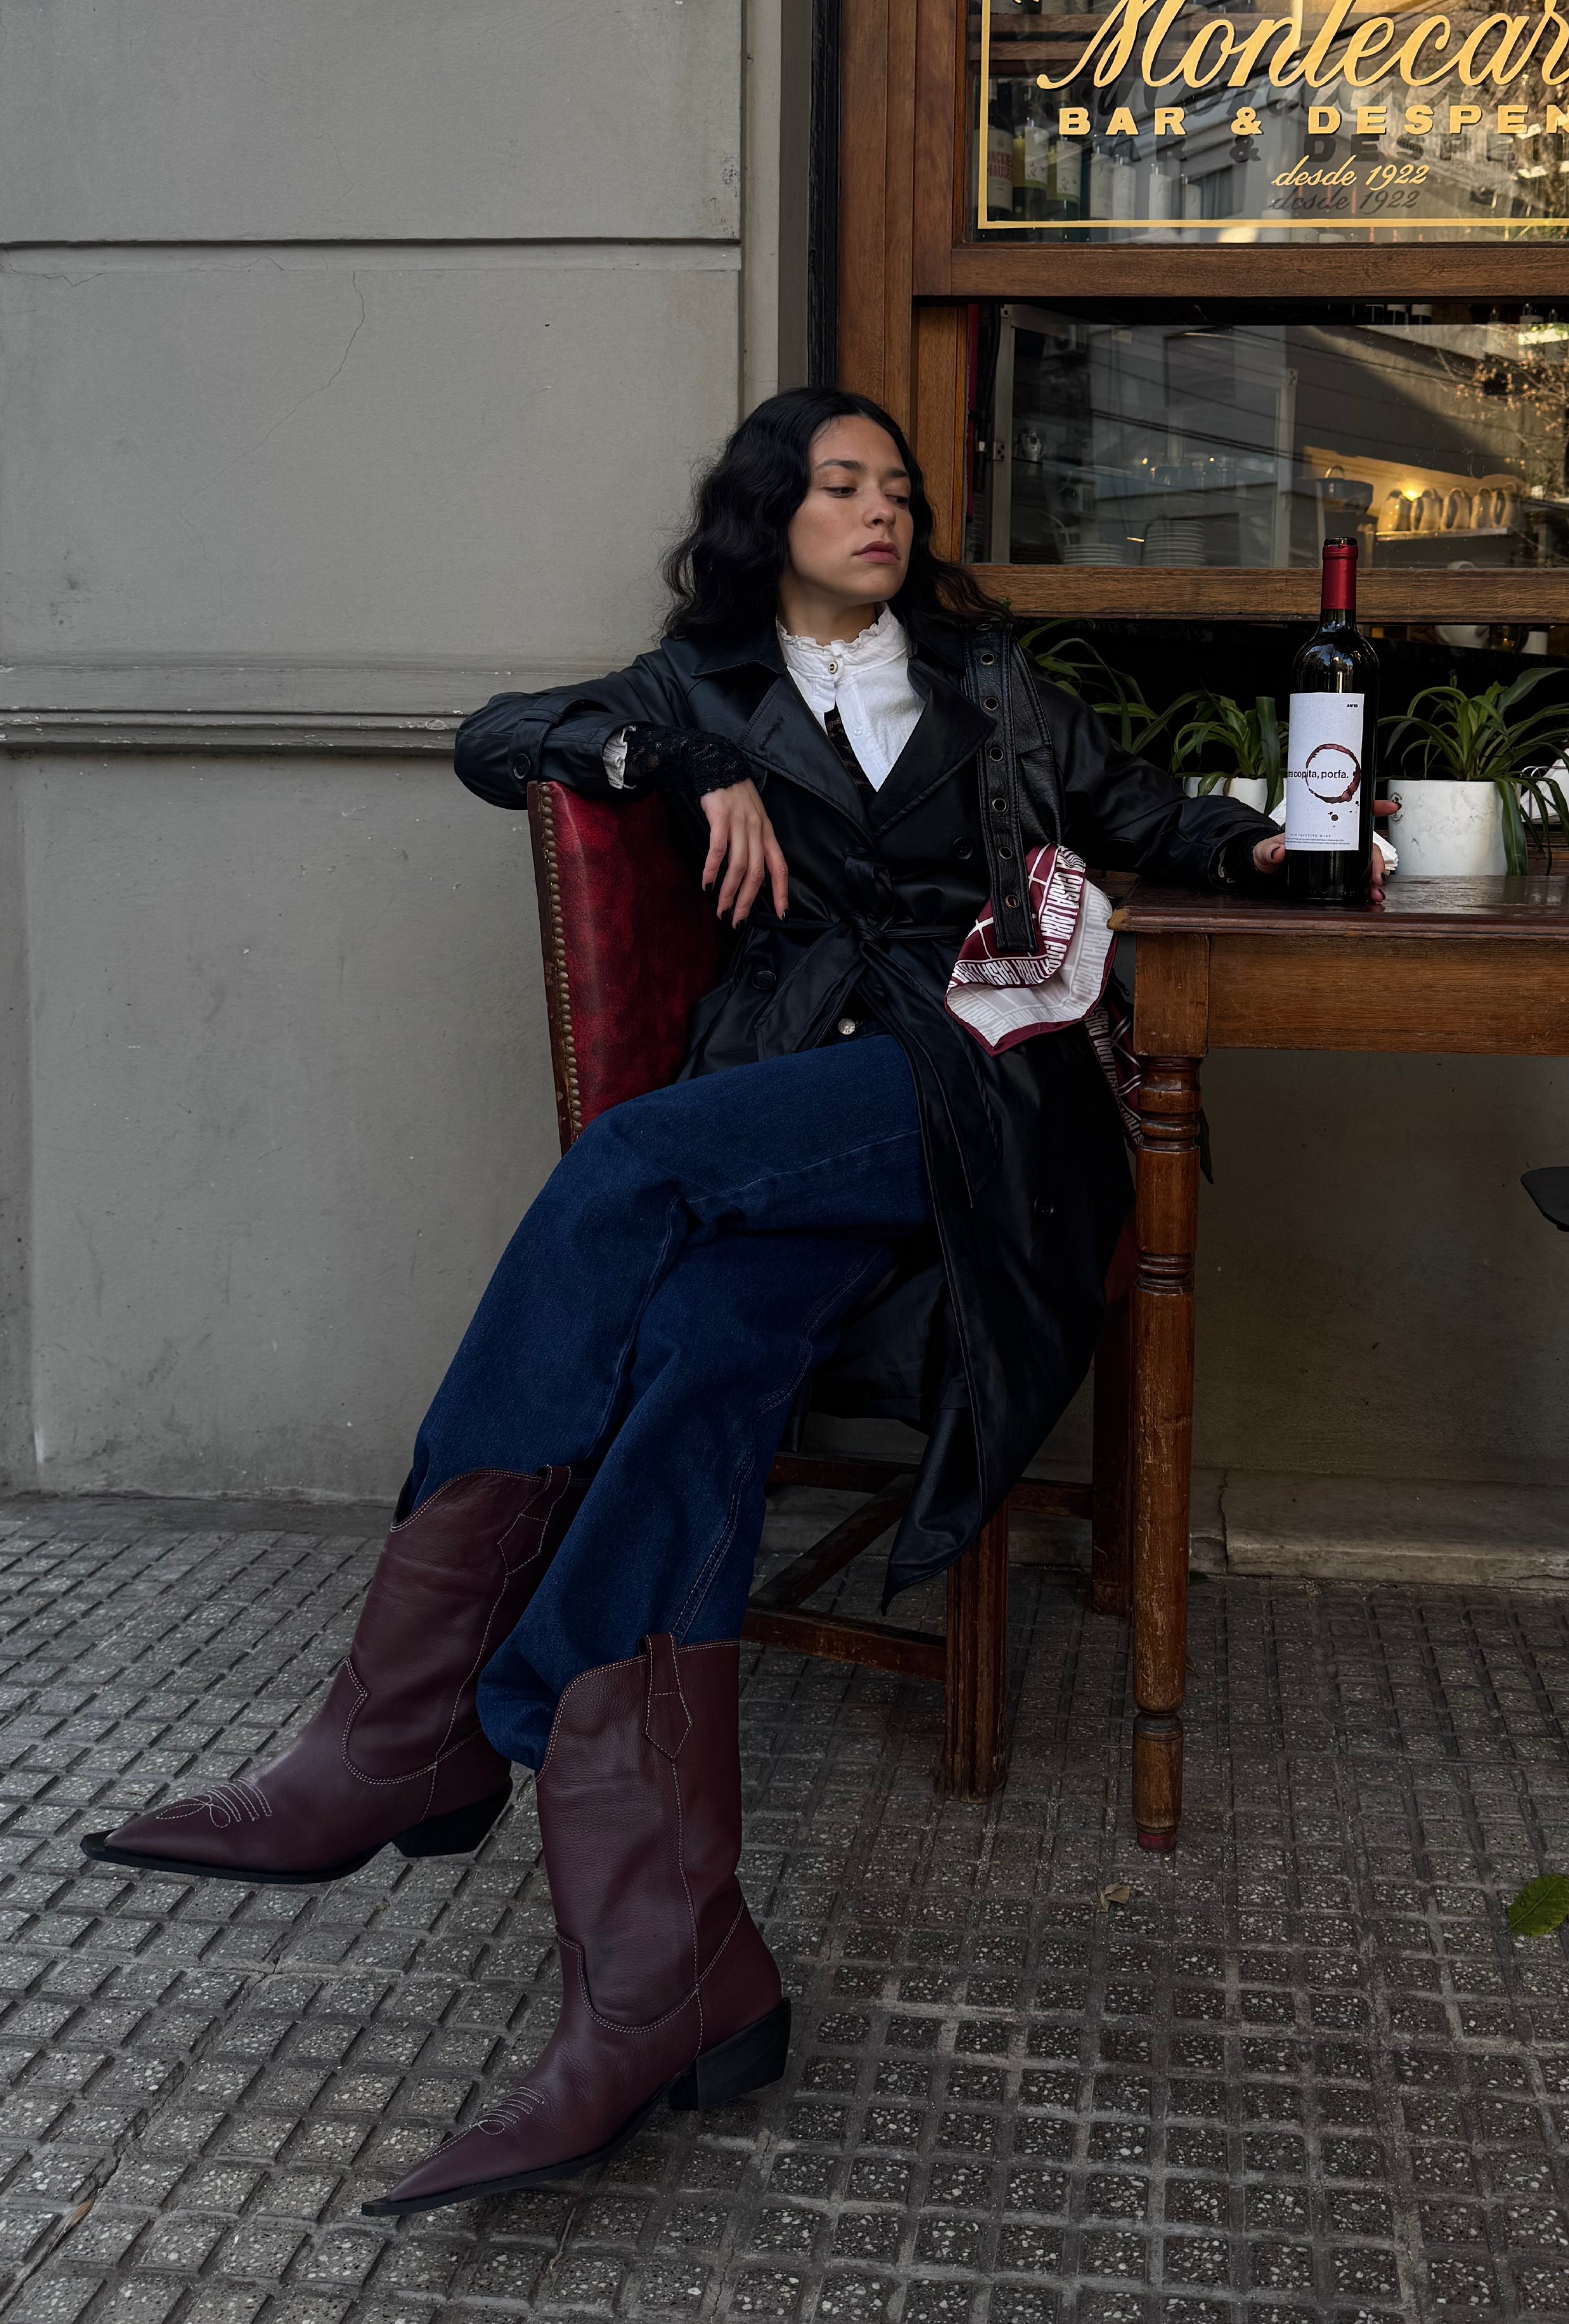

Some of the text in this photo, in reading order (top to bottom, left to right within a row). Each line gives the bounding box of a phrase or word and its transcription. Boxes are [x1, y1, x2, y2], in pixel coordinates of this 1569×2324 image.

[1059, 104, 1569, 136] BAR & DESPEN
[1271, 155, 1430, 192] desde 1922
[1321, 770, 1349, 780] porfa.
